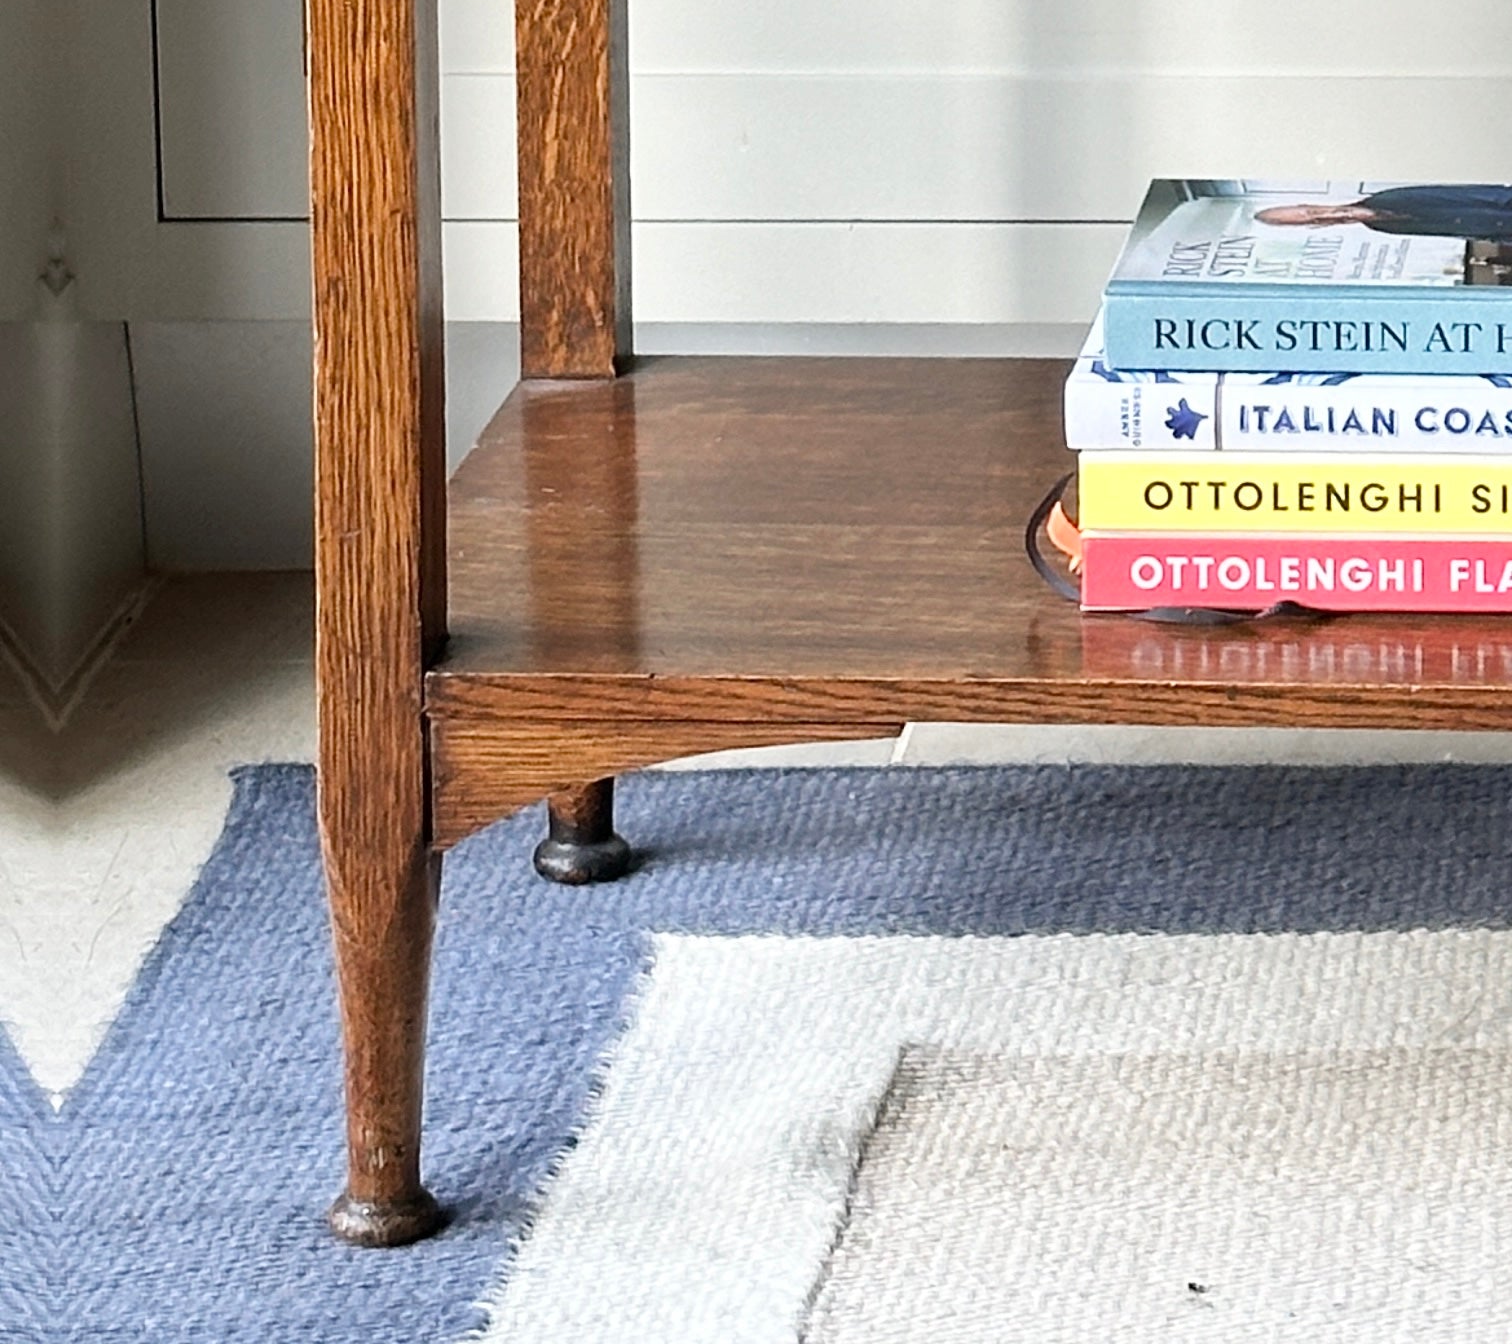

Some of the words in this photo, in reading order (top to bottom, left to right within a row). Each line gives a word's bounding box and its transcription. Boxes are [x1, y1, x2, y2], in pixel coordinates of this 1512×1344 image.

[1163, 241, 1212, 277] RICK
[1207, 235, 1256, 278] STEIN
[1154, 317, 1262, 350] RICK
[1275, 319, 1407, 352] STEIN
[1425, 322, 1482, 353] AT
[1239, 404, 1396, 435] ITALIAN
[1143, 480, 1442, 513] OTTOLENGHI
[1130, 555, 1423, 593] OTTOLENGHI
